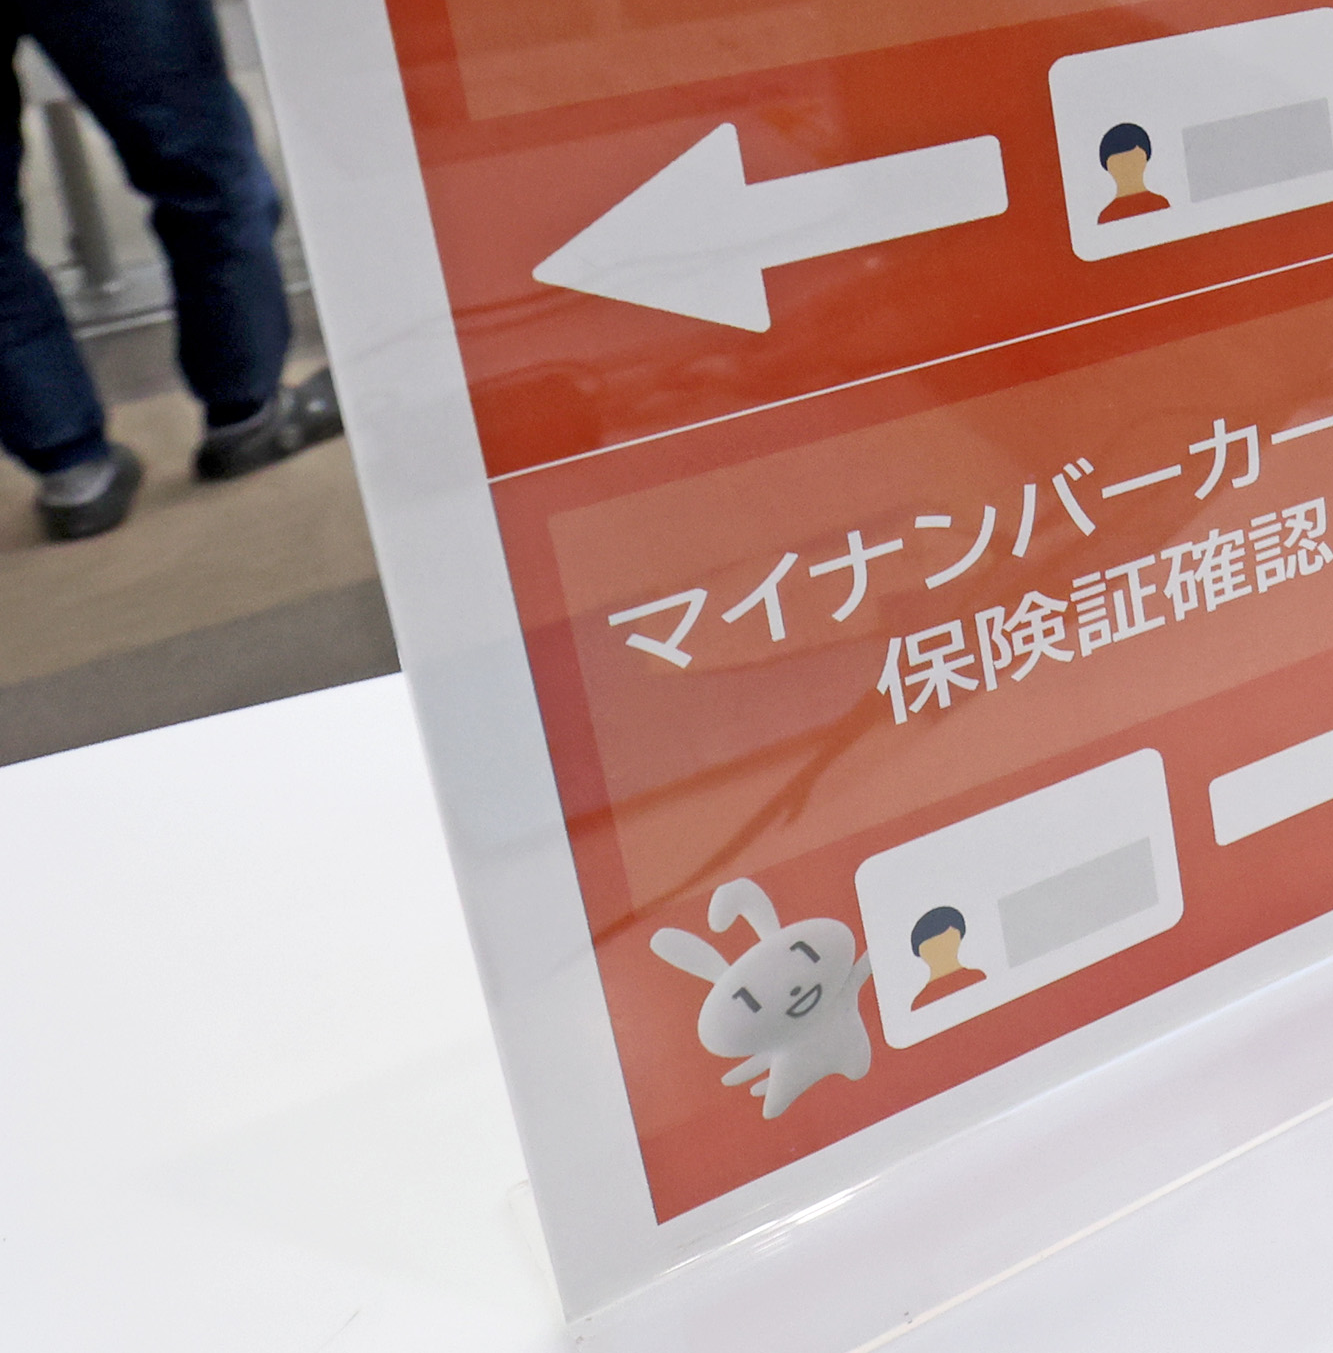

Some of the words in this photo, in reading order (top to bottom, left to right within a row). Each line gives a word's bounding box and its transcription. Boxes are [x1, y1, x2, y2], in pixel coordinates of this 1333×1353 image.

[877, 497, 1333, 726] 保険証確認
